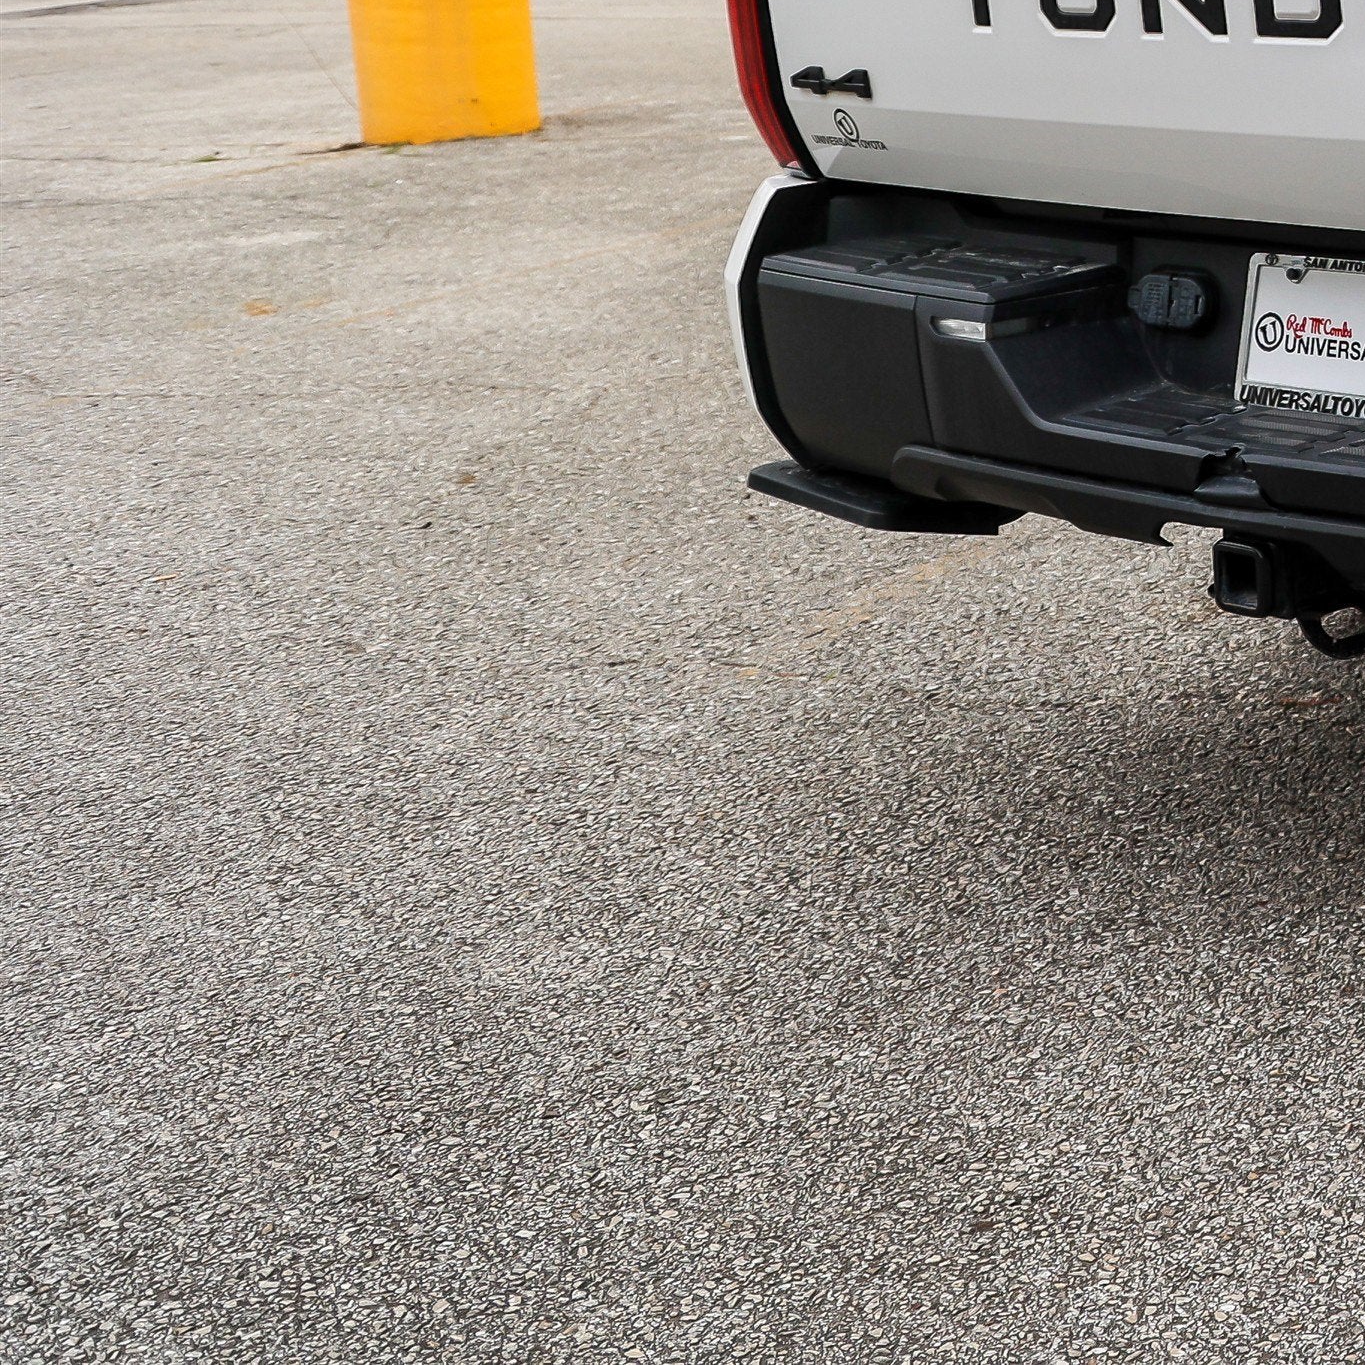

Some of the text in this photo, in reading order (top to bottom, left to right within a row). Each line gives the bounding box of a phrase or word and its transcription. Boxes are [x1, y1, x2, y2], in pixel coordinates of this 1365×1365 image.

[811, 135, 888, 150] UNIVERSAL TOYOTA
[1303, 256, 1328, 269] SAN
[1286, 314, 1352, 339] Red McCombs
